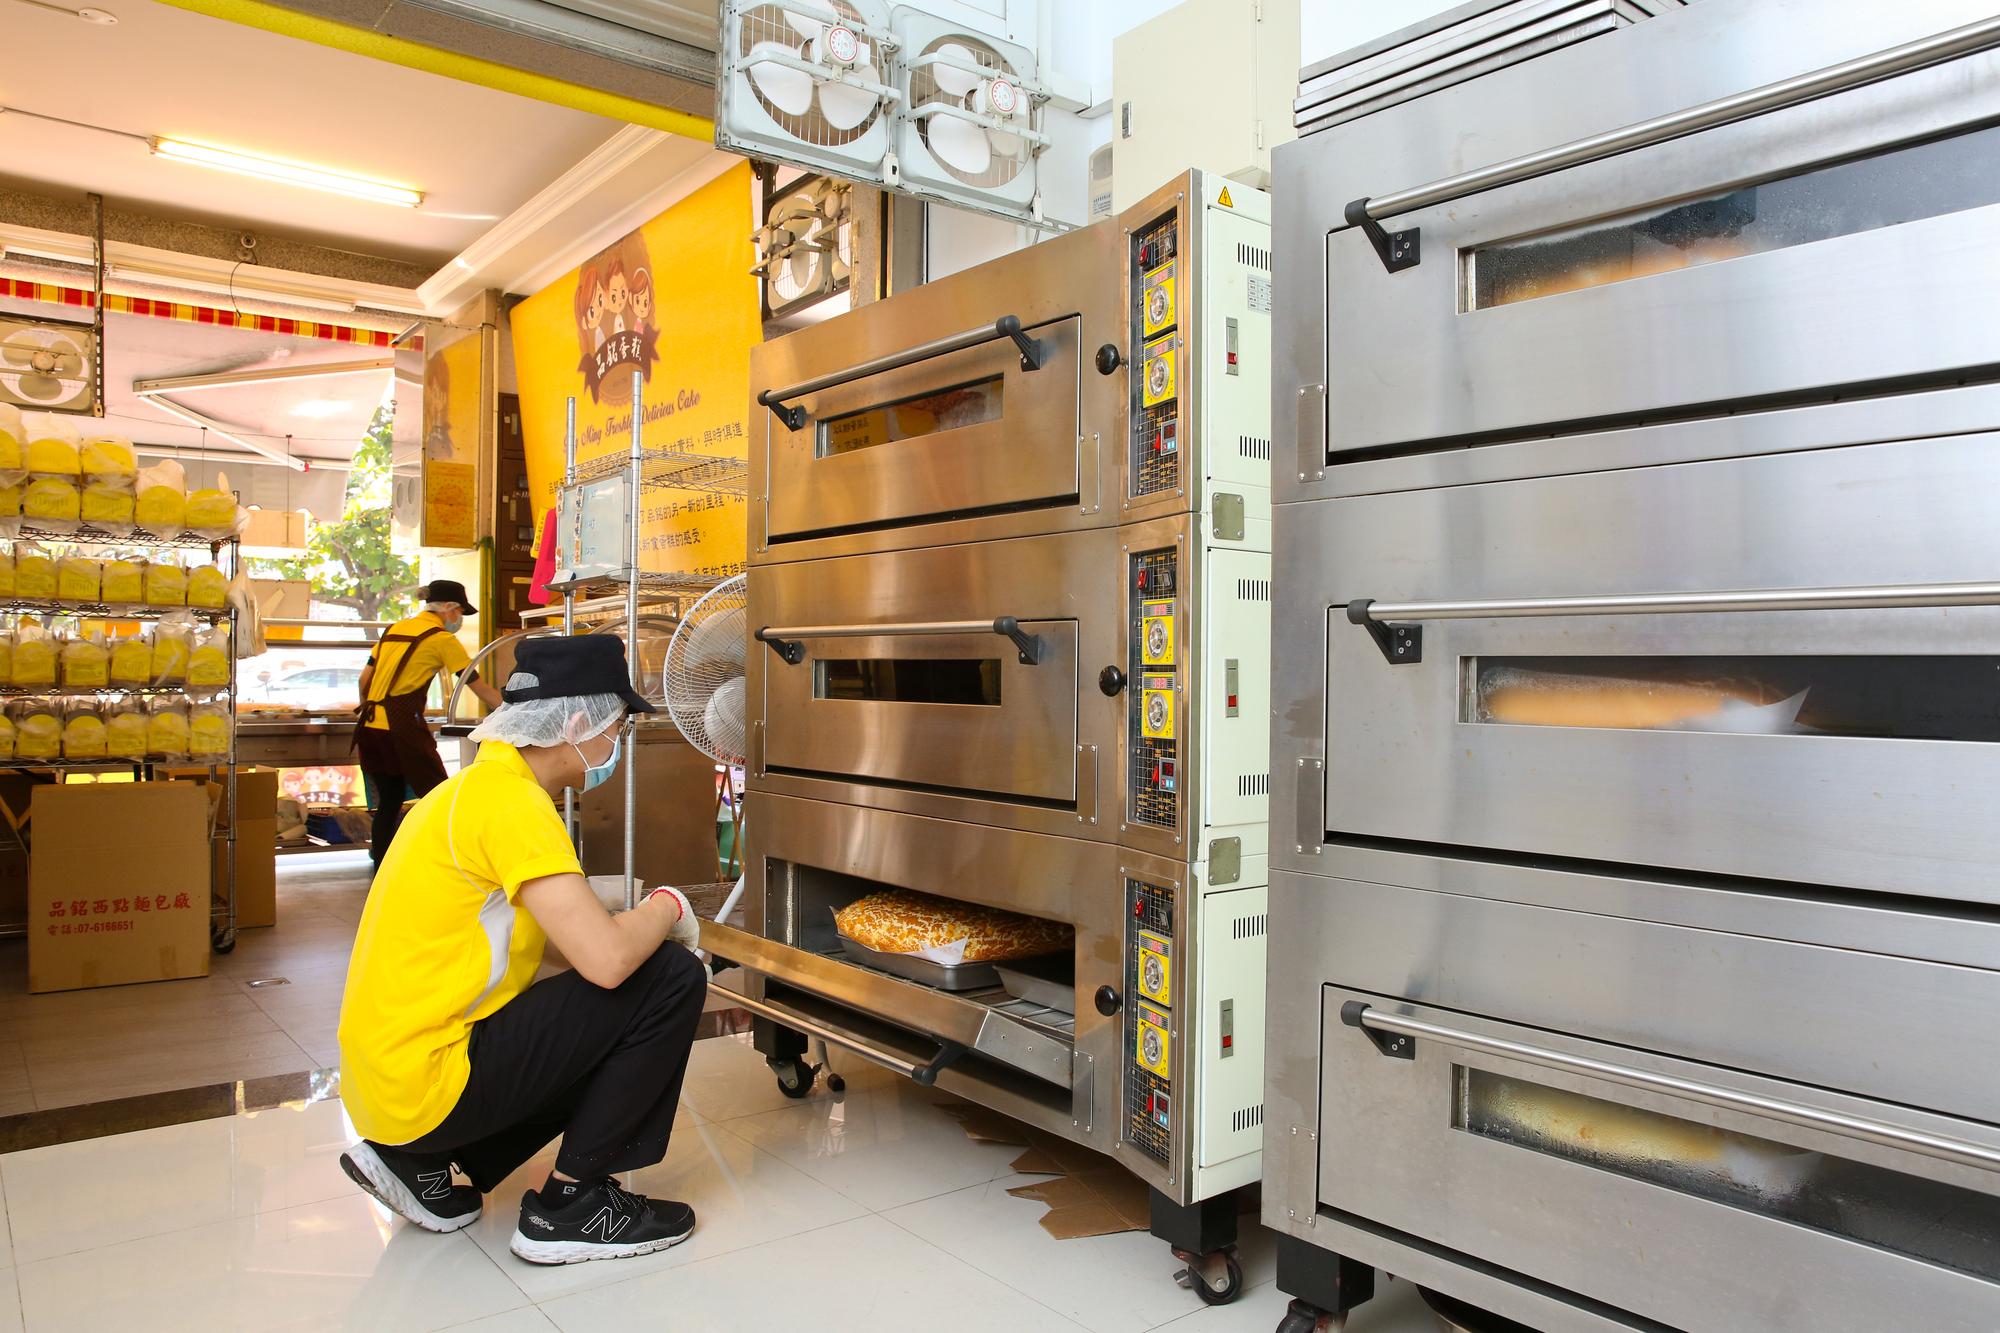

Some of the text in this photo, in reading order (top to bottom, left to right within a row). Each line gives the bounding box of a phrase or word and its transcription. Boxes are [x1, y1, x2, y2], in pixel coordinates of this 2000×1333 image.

[581, 424, 602, 446] Ming
[677, 389, 701, 411] Cake
[48, 892, 192, 917] 品銘西點麵包廠
[581, 1206, 631, 1243] N
